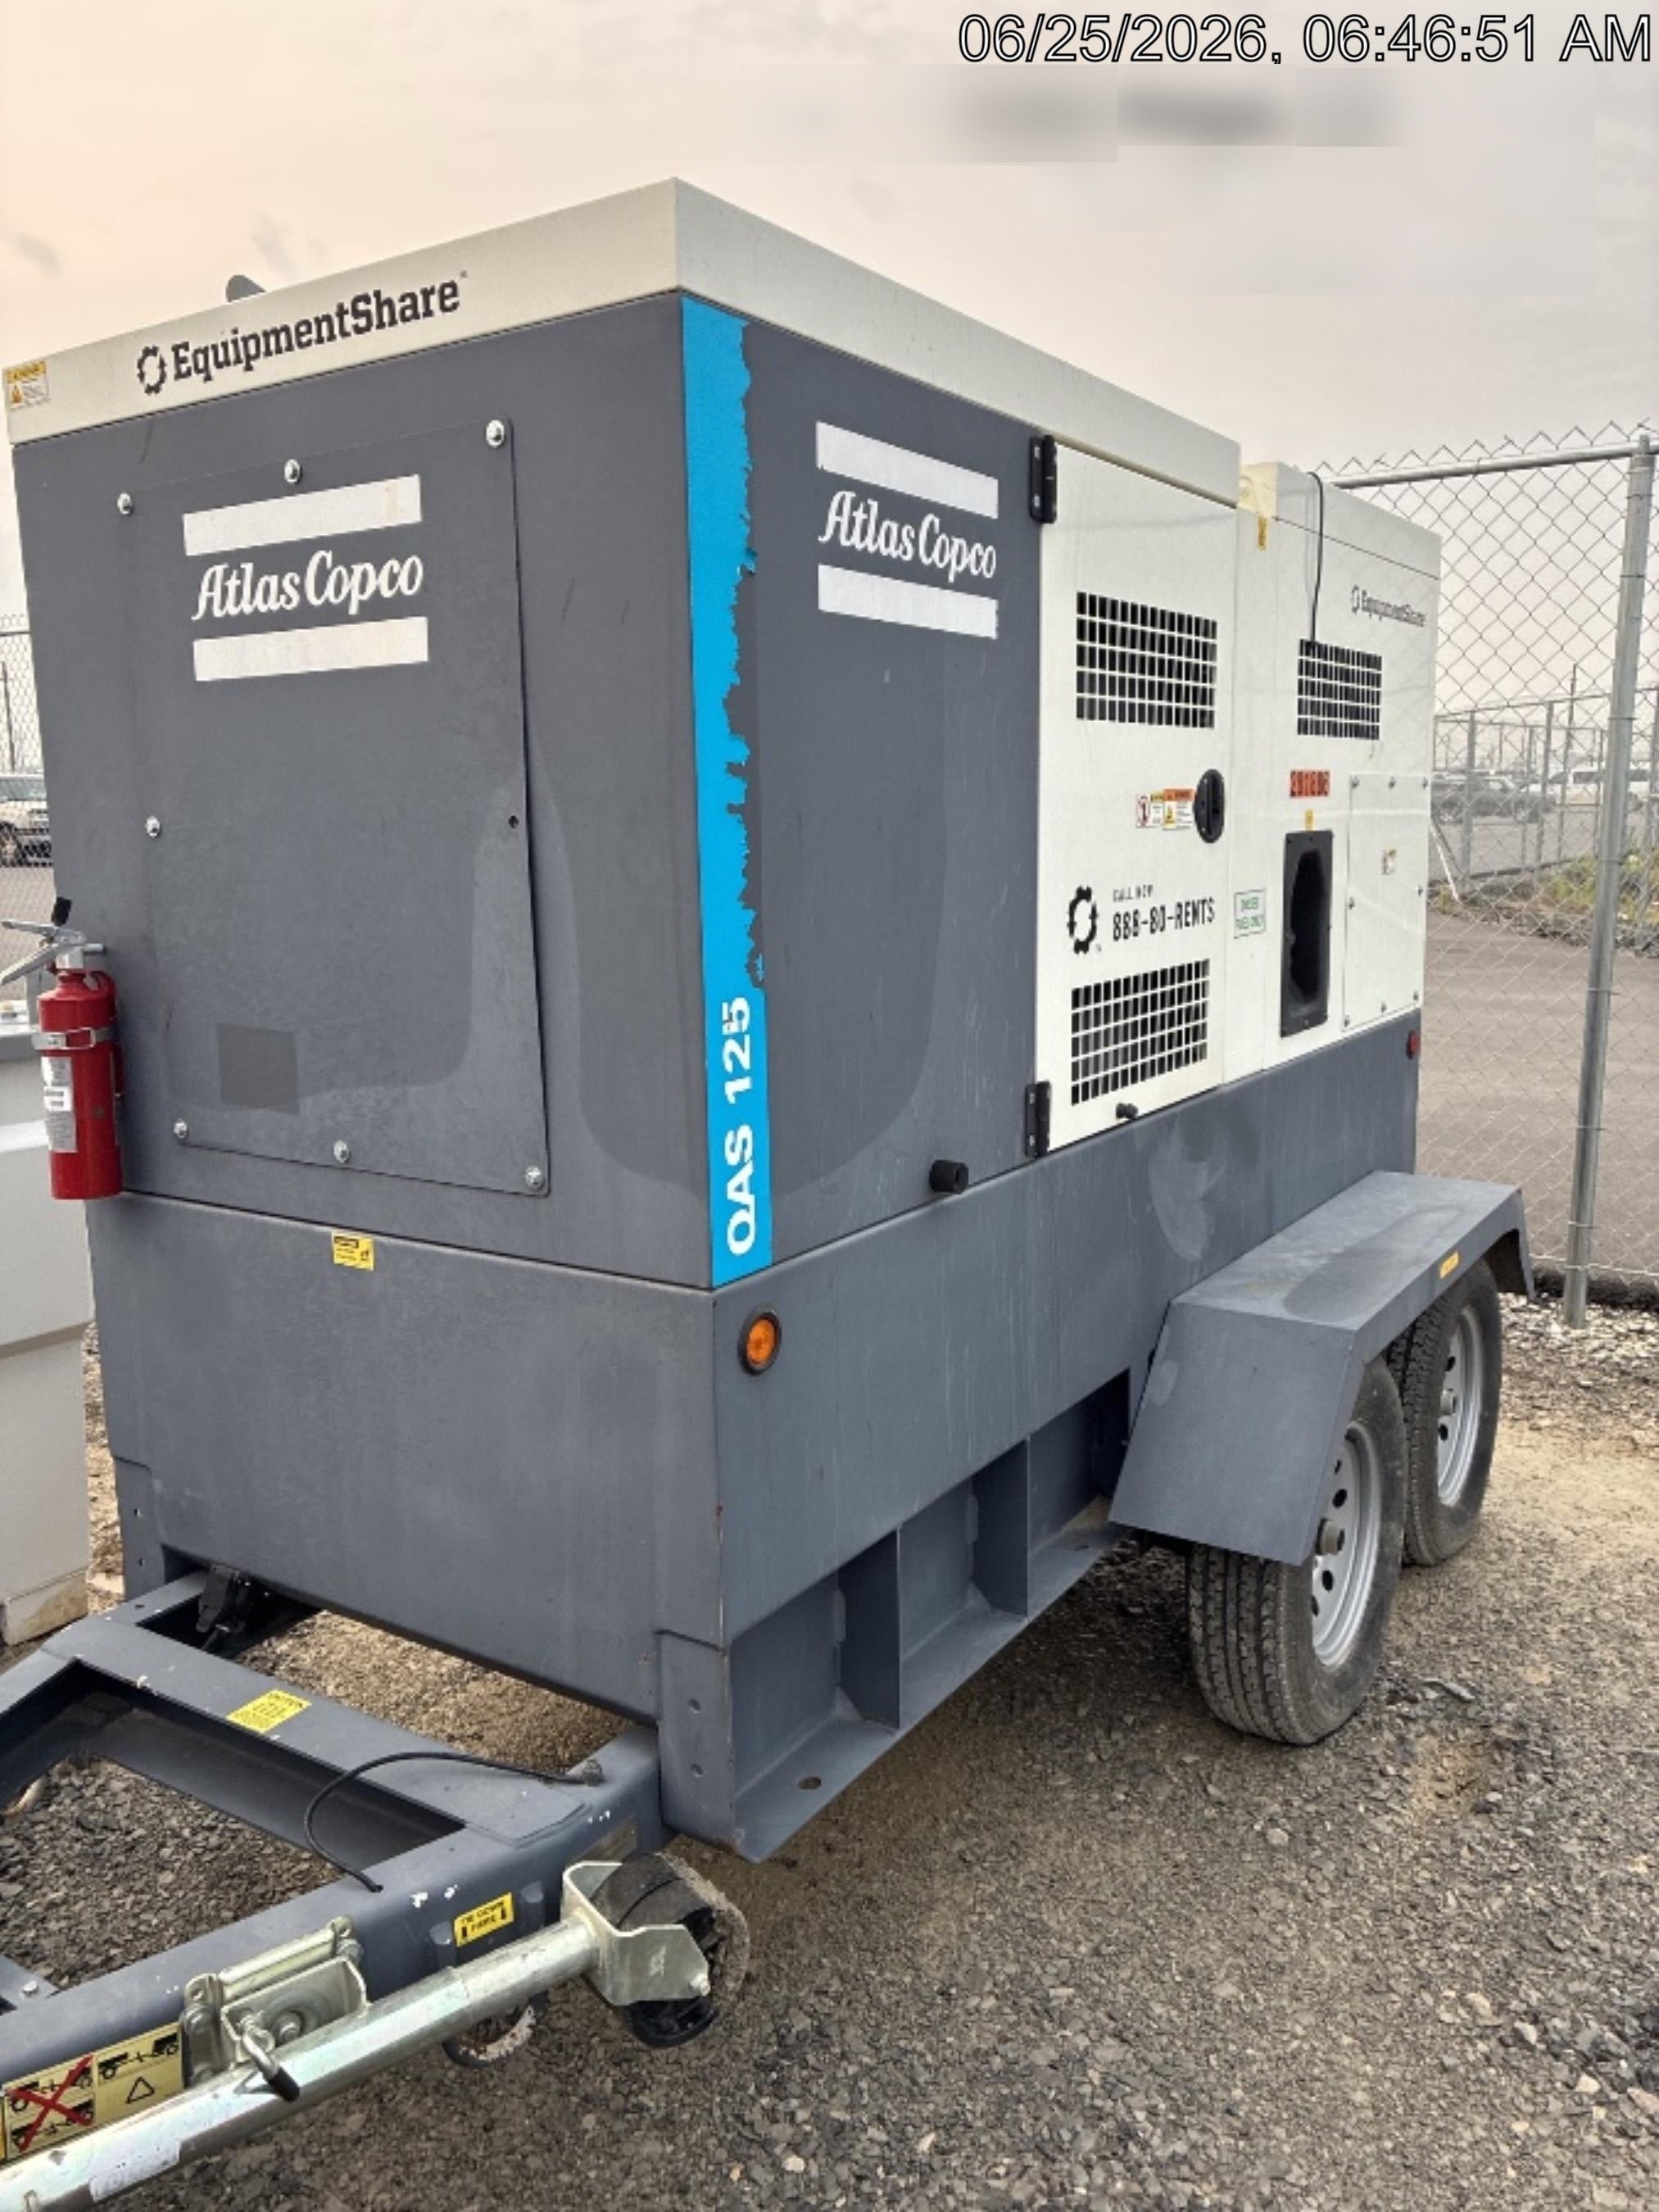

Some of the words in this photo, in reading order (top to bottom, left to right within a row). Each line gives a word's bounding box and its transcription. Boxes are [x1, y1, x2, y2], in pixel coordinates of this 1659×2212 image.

[172, 279, 460, 383] EquipmentShare
[191, 563, 300, 621] Atlas
[304, 550, 424, 615] Copco
[818, 491, 915, 562] Atlas
[918, 513, 997, 583] Copco
[1113, 897, 1215, 942] 888-80-RENTS
[722, 996, 753, 1104] 125
[726, 1125, 756, 1255] QAS
